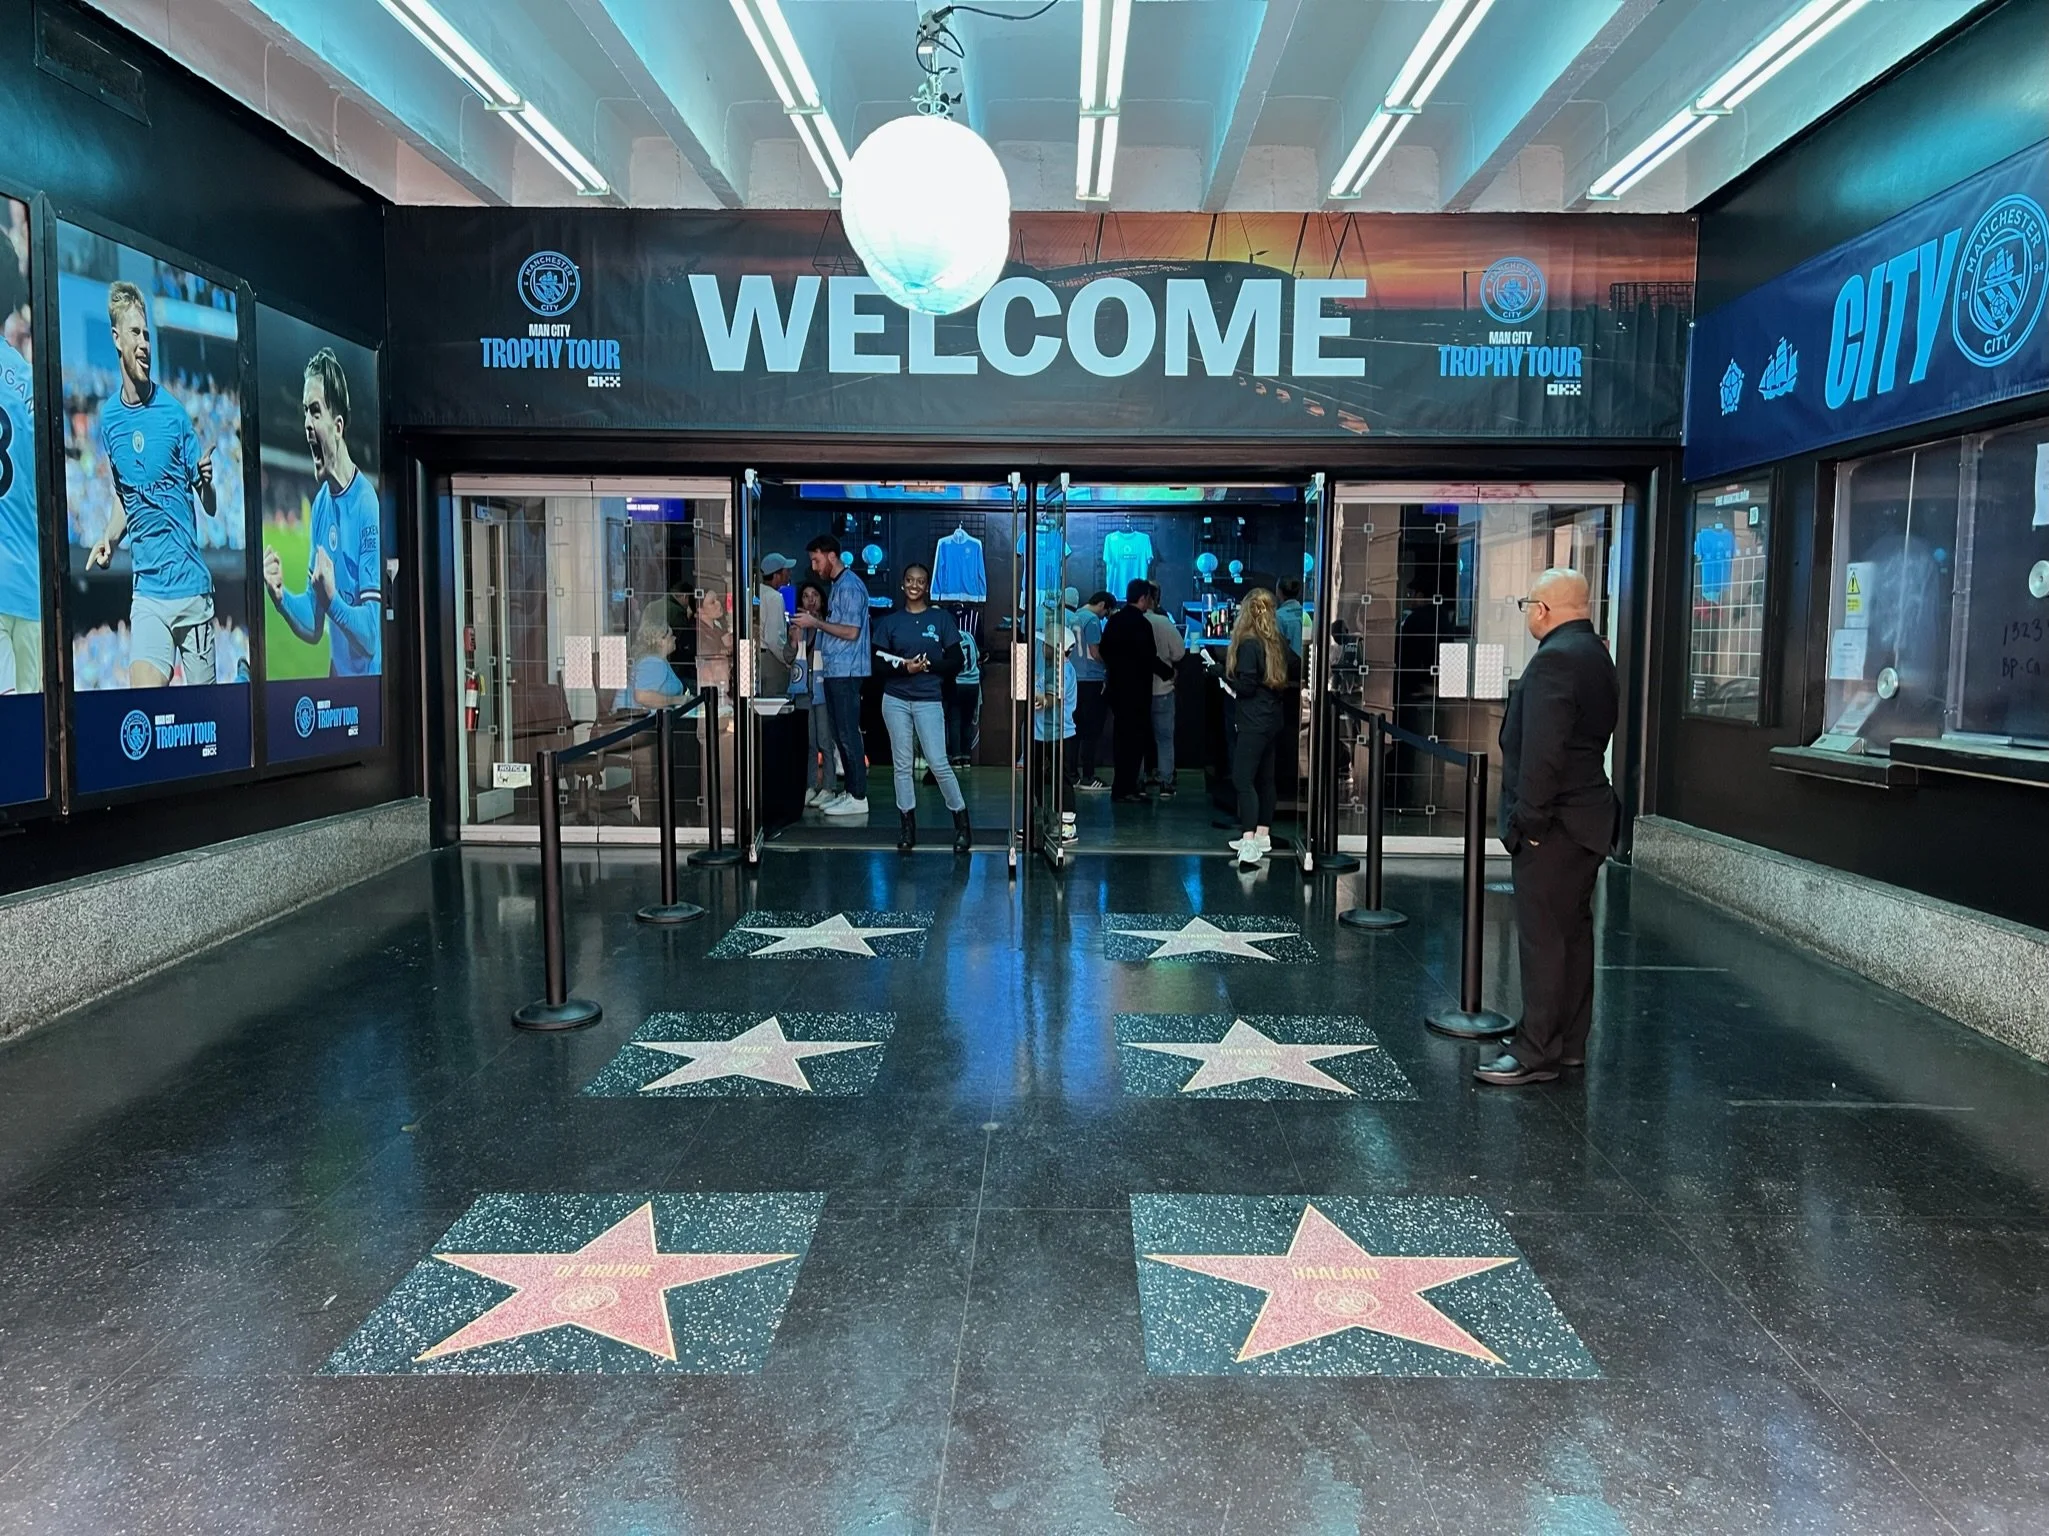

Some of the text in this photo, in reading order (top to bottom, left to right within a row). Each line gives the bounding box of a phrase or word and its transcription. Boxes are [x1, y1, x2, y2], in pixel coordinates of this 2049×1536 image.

[1966, 209, 2043, 274] MANCHESTER
[523, 256, 574, 277] MANCHESTER
[1488, 262, 1539, 282] MANCHESTER
[2033, 261, 2044, 275] 94
[540, 304, 559, 312] CITY
[688, 273, 1367, 377] WELCOME
[1825, 227, 1963, 410] CITY
[528, 323, 571, 337] MAN CITY
[1488, 331, 1533, 344] MAN CITY
[480, 338, 620, 369] TROPHY TOUR
[1984, 333, 2012, 355] CITY
[1438, 345, 1582, 377] TROPHY TOUR
[587, 376, 621, 388] OKX
[1546, 384, 1582, 396] OKX
[317, 706, 359, 729] TROPHY TOUR
[155, 721, 217, 749] TROPHY TOUR
[553, 1264, 655, 1278] DE BRUYNE
[1290, 1266, 1380, 1280] HAALAND
